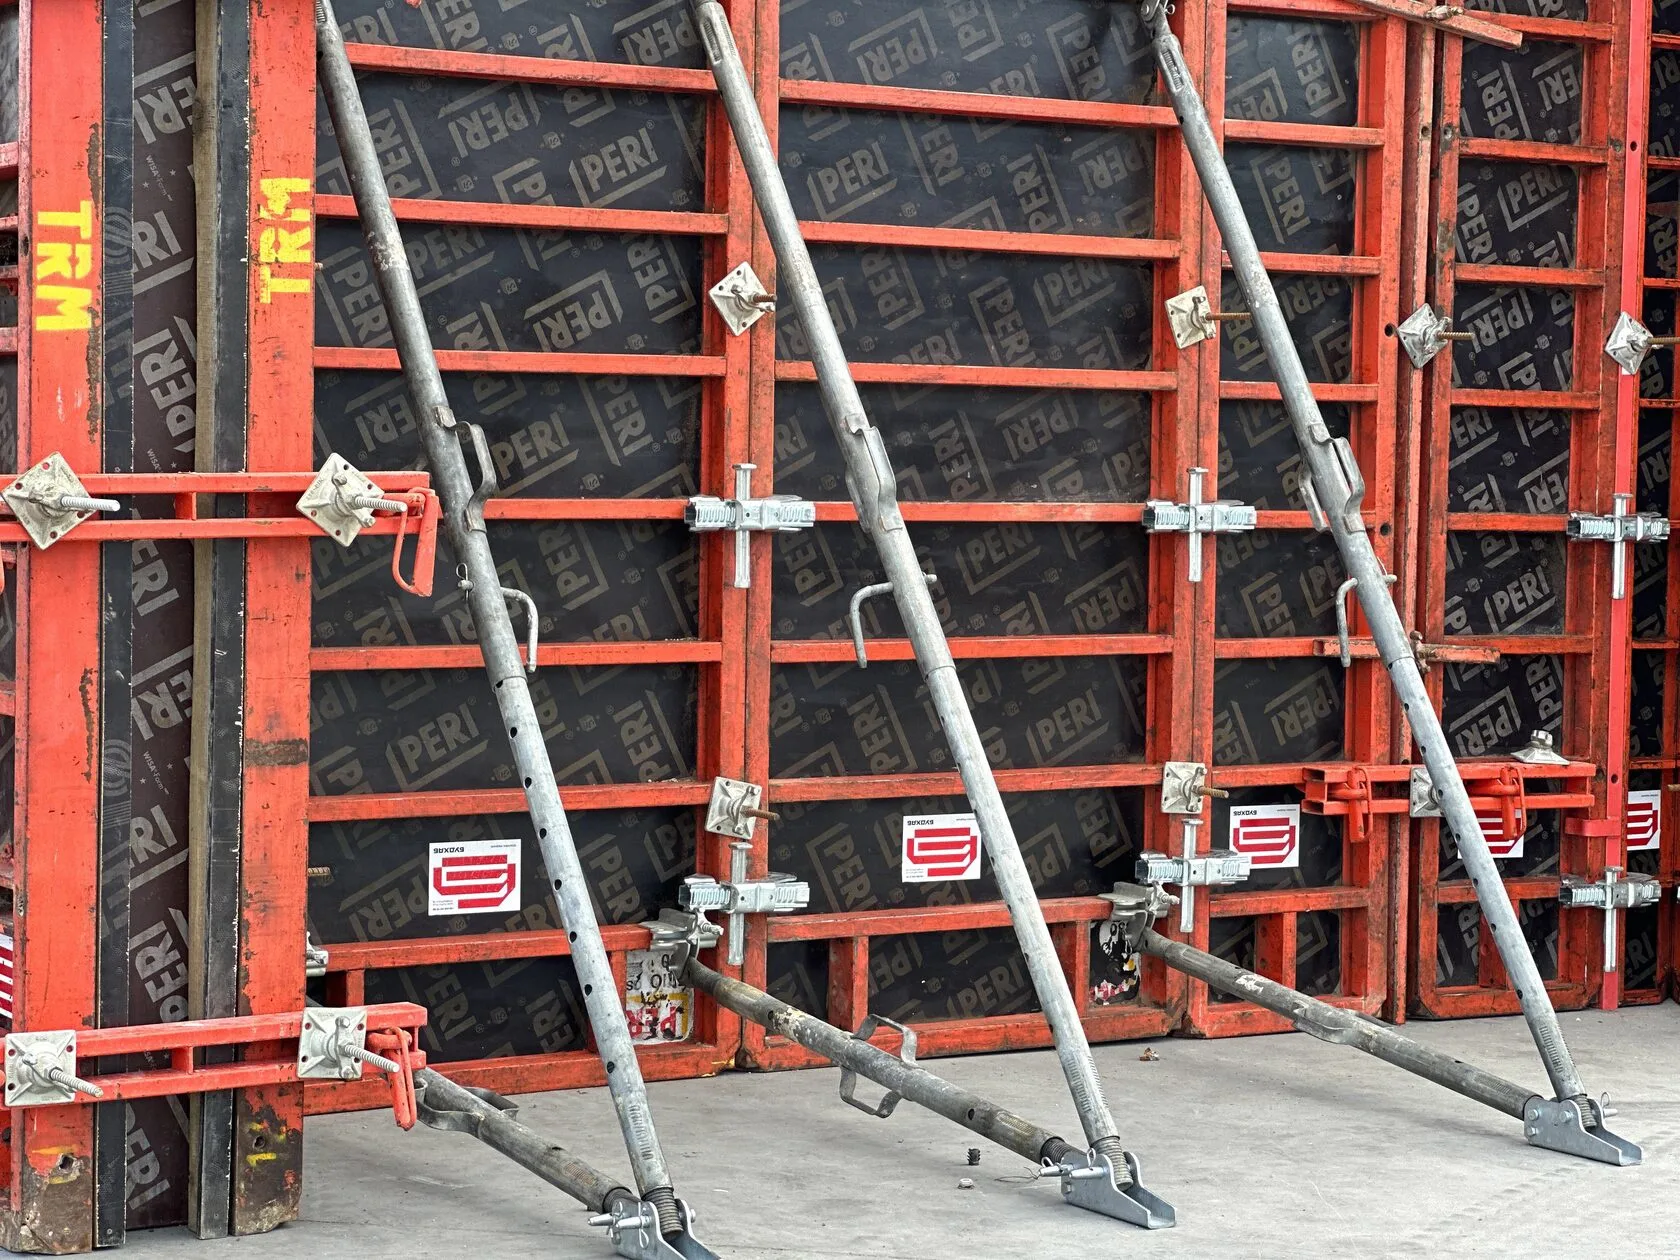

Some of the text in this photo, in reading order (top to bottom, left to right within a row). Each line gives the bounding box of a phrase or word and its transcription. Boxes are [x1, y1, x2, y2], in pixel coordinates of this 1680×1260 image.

[434, 0, 488, 50] ERI
[622, 9, 699, 64] PERI
[856, 28, 928, 84] PERI
[1062, 25, 1112, 101] PERI
[1286, 26, 1331, 105] PERI
[1538, 64, 1580, 111] ERI
[133, 75, 197, 144] ERI
[448, 92, 529, 159] PERI
[1477, 69, 1519, 139] PERI
[581, 127, 658, 192] PERI
[818, 141, 890, 204] PERI
[1007, 153, 1057, 232] PERI
[1264, 157, 1311, 236] PERI
[1458, 194, 1498, 264] PERI
[35, 200, 92, 331] TRM
[133, 210, 182, 273] RI
[259, 178, 311, 304] TRM
[621, 236, 678, 311] PER
[332, 260, 394, 348] PERI
[861, 254, 909, 318] PER
[533, 291, 612, 352] PERI
[984, 285, 1037, 366] PERI
[1467, 295, 1525, 353] PERI
[354, 394, 417, 452] ERI
[489, 411, 570, 480] PERI
[1002, 399, 1069, 461] PERI
[1450, 408, 1493, 448] ERI
[928, 419, 981, 499] PERI
[1524, 472, 1568, 513] ERI
[133, 540, 180, 616] ERI
[530, 523, 590, 598] PER
[1493, 565, 1550, 623] PERI
[1071, 577, 1136, 634] PERI
[132, 669, 192, 741] ERI
[1036, 688, 1102, 751] PERI
[1271, 683, 1332, 746] PERI
[1525, 656, 1562, 720] PER
[397, 702, 480, 774] PERI
[612, 700, 672, 782] PERI
[847, 693, 900, 774] PERI
[1455, 704, 1513, 757] PERI
[130, 804, 178, 869] RI
[1074, 788, 1118, 857] PER
[589, 845, 648, 924] PERI
[824, 834, 878, 911] PERI
[424, 968, 477, 1041] ERI
[525, 990, 575, 1054] ERI
[957, 958, 1025, 1018] PERI
